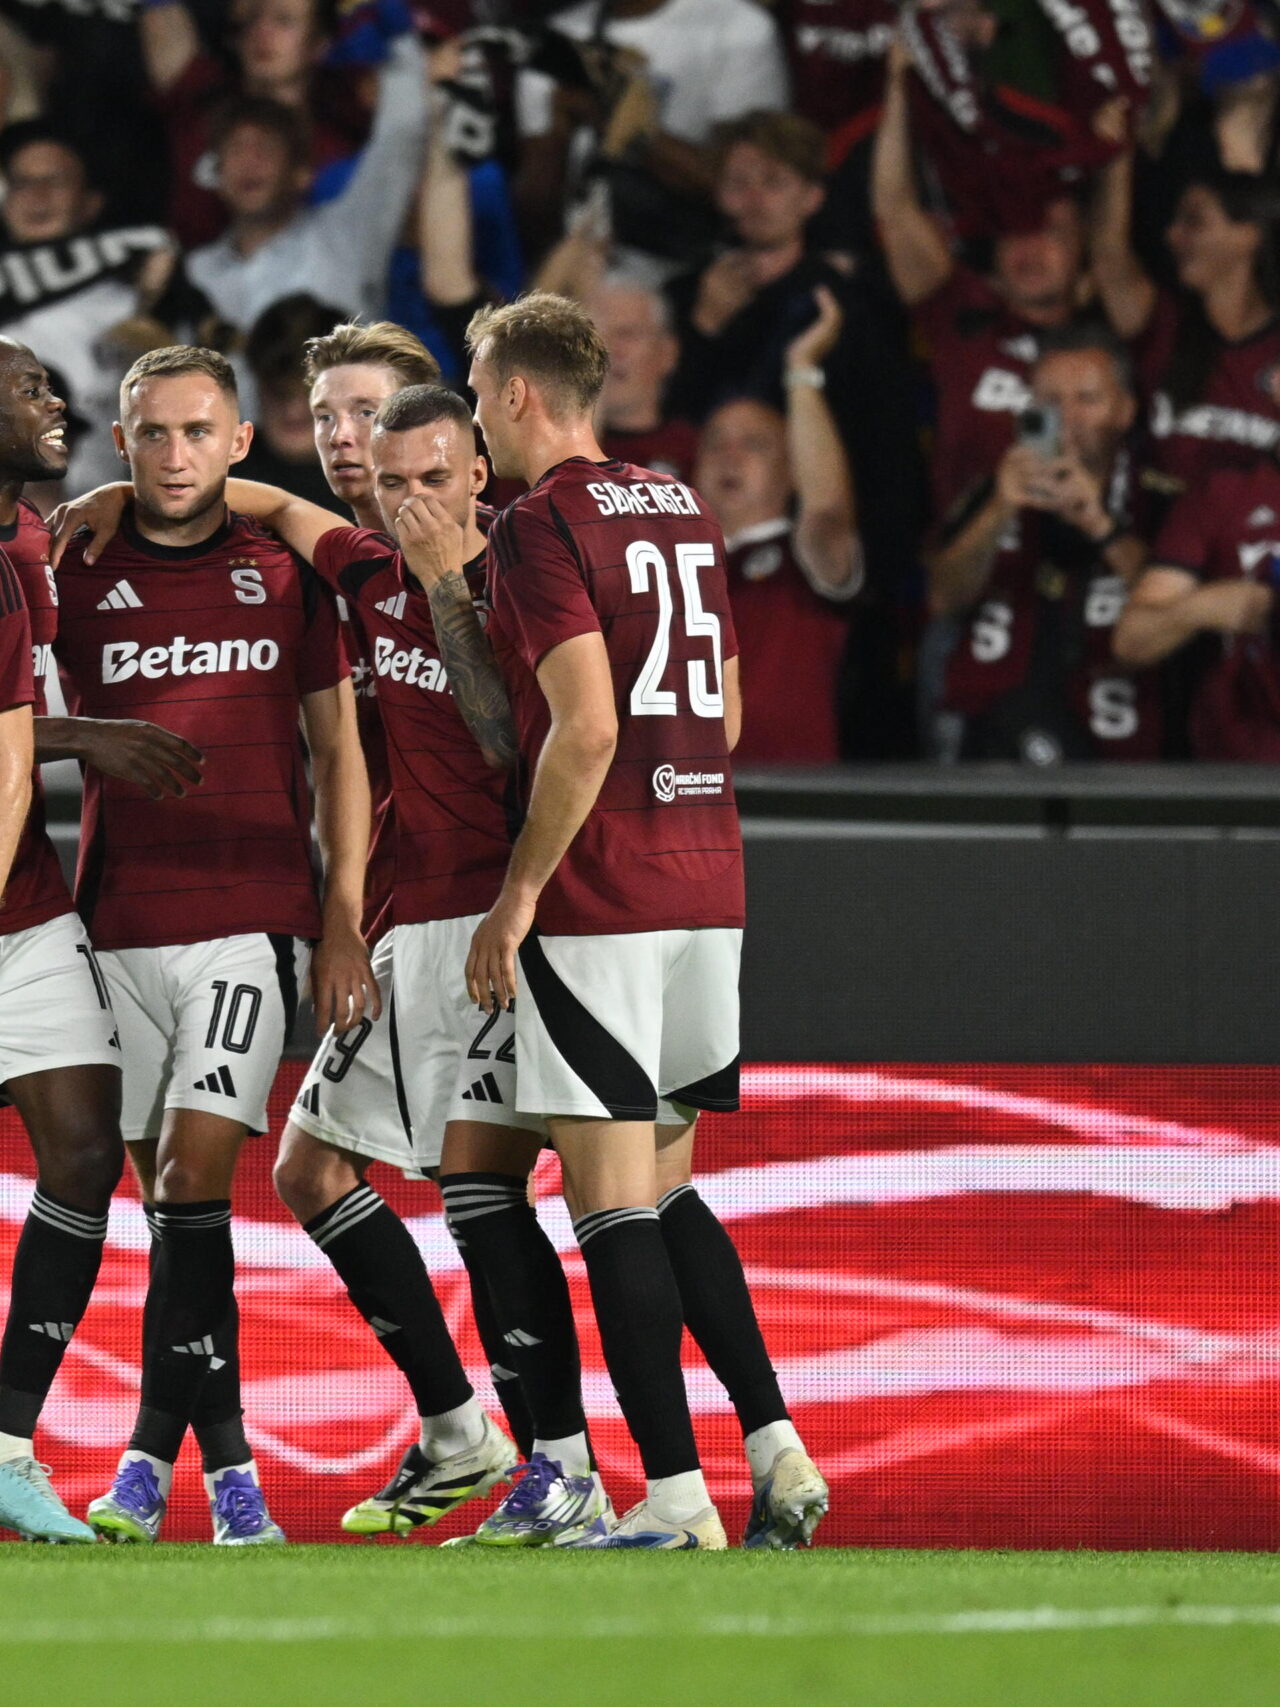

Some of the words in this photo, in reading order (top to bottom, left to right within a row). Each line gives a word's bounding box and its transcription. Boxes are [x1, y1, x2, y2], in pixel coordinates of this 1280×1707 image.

[231, 569, 266, 604] S
[625, 541, 724, 718] 25
[102, 636, 279, 684] Betano
[375, 636, 454, 695] Beta
[702, 773, 724, 784] FOND
[204, 979, 263, 1055] 10
[496, 1521, 552, 1532] F50
